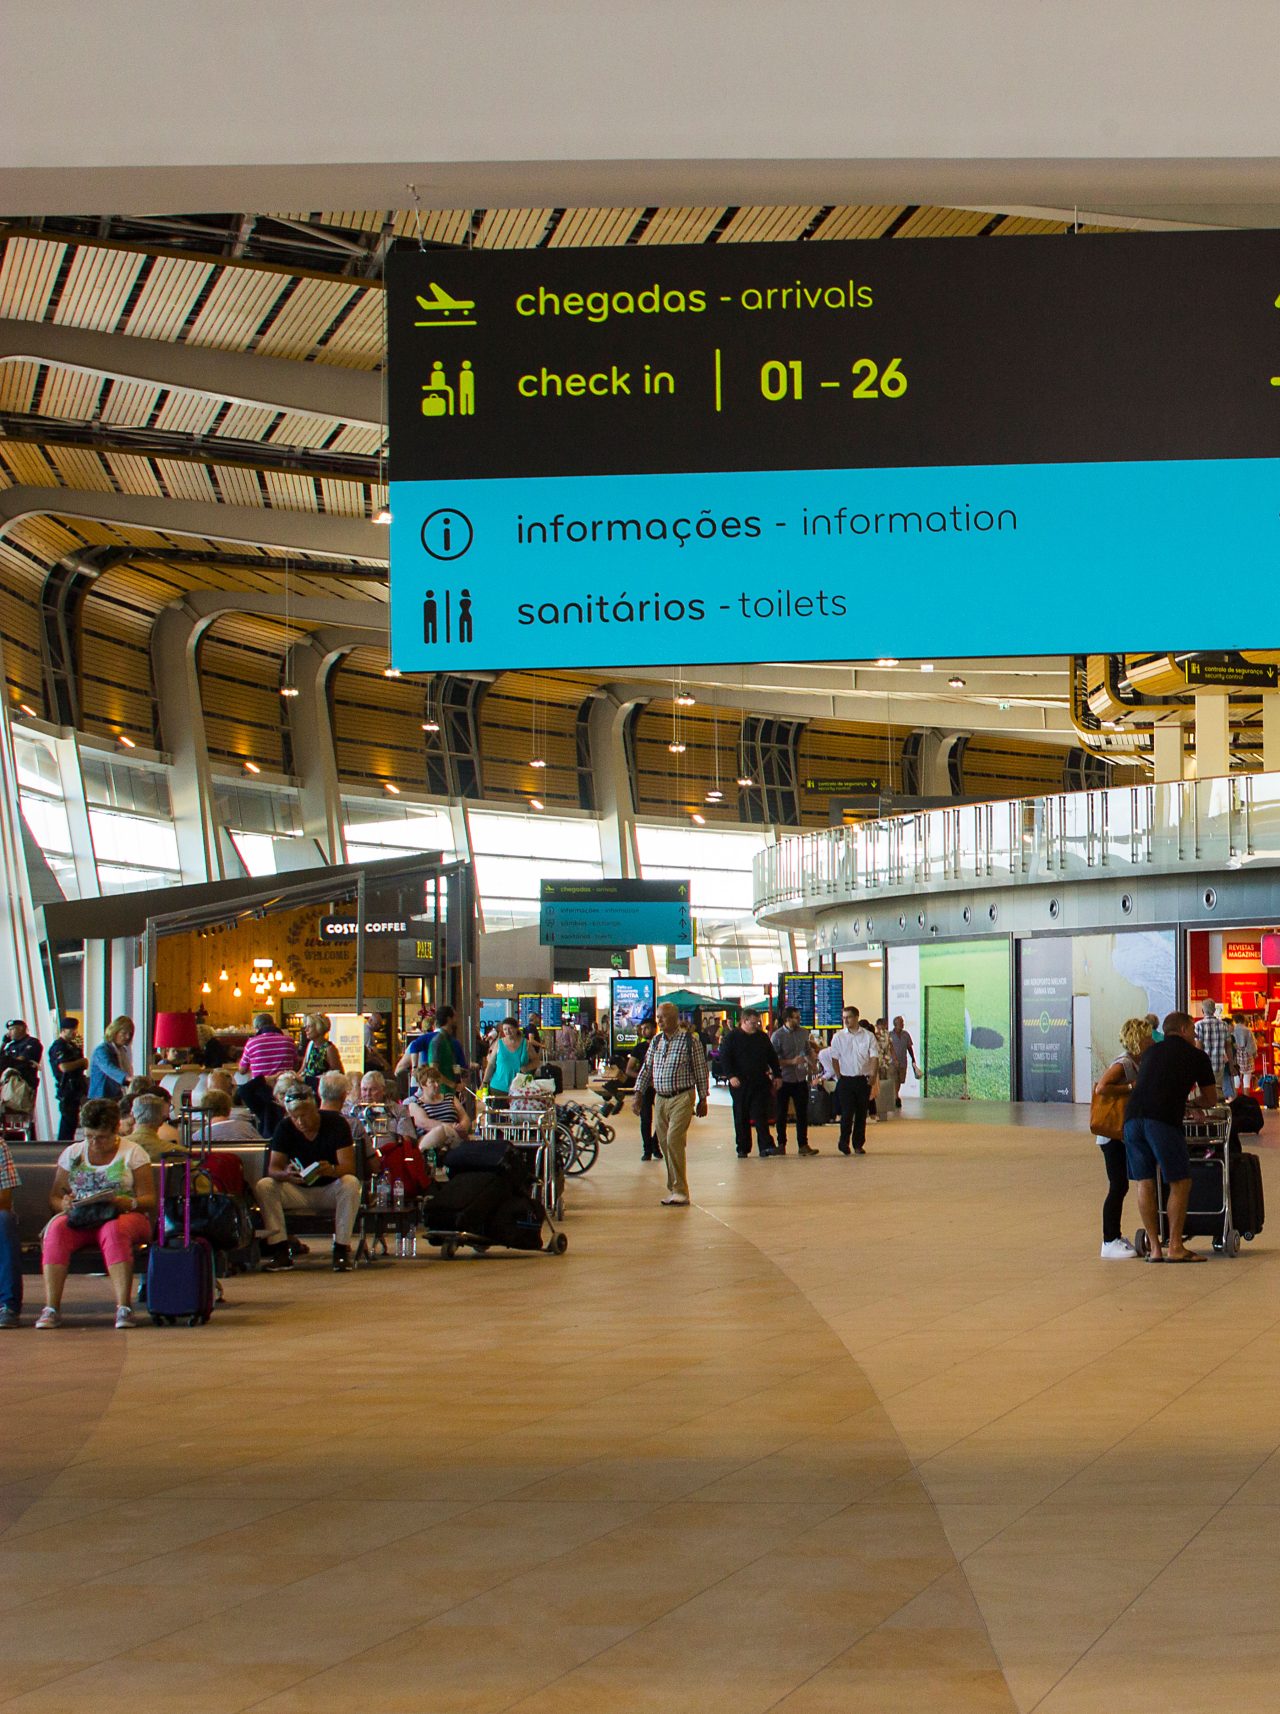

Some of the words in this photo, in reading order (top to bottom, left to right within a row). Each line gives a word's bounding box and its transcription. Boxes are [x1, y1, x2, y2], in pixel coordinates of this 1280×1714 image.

[516, 283, 707, 323] chegadas
[741, 279, 873, 311] arrivals
[518, 365, 631, 397] check
[644, 364, 675, 395] in
[760, 360, 803, 401] 01
[851, 357, 909, 399] 26
[517, 509, 761, 548] informações
[803, 503, 1018, 536] information
[517, 591, 705, 625] sanitários
[738, 588, 847, 619] toilets
[365, 922, 407, 933] COFFEE
[416, 941, 434, 959] PAUL
